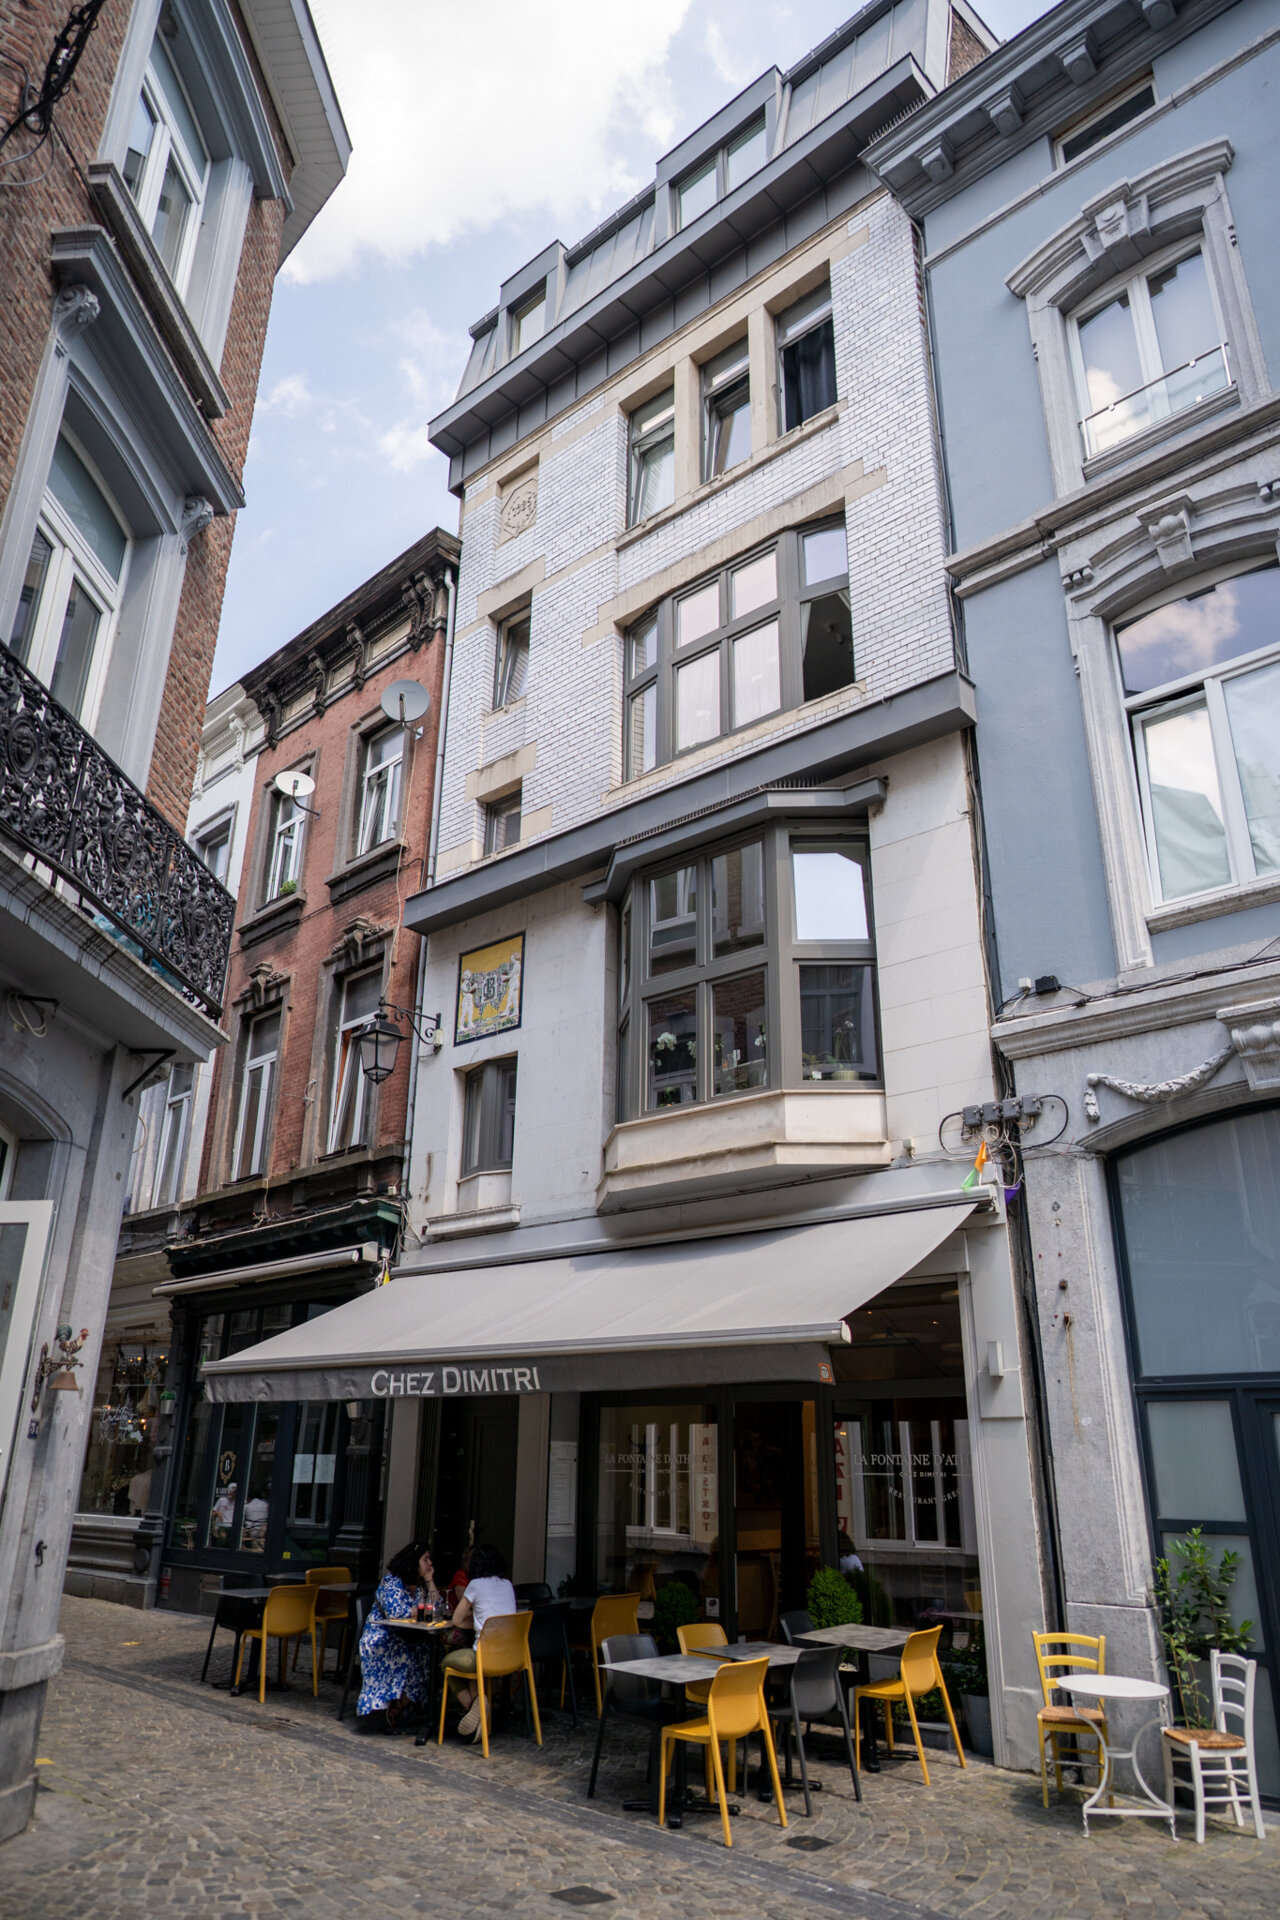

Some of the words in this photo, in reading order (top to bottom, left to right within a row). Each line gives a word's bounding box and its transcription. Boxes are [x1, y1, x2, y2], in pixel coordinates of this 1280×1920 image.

[371, 1369, 435, 1396] CHEZ
[441, 1366, 542, 1394] DIMITRI
[605, 1453, 616, 1464] LA
[854, 1454, 868, 1466] LA
[870, 1454, 930, 1466] FONTAINE
[888, 1486, 938, 1505] RESURANT
